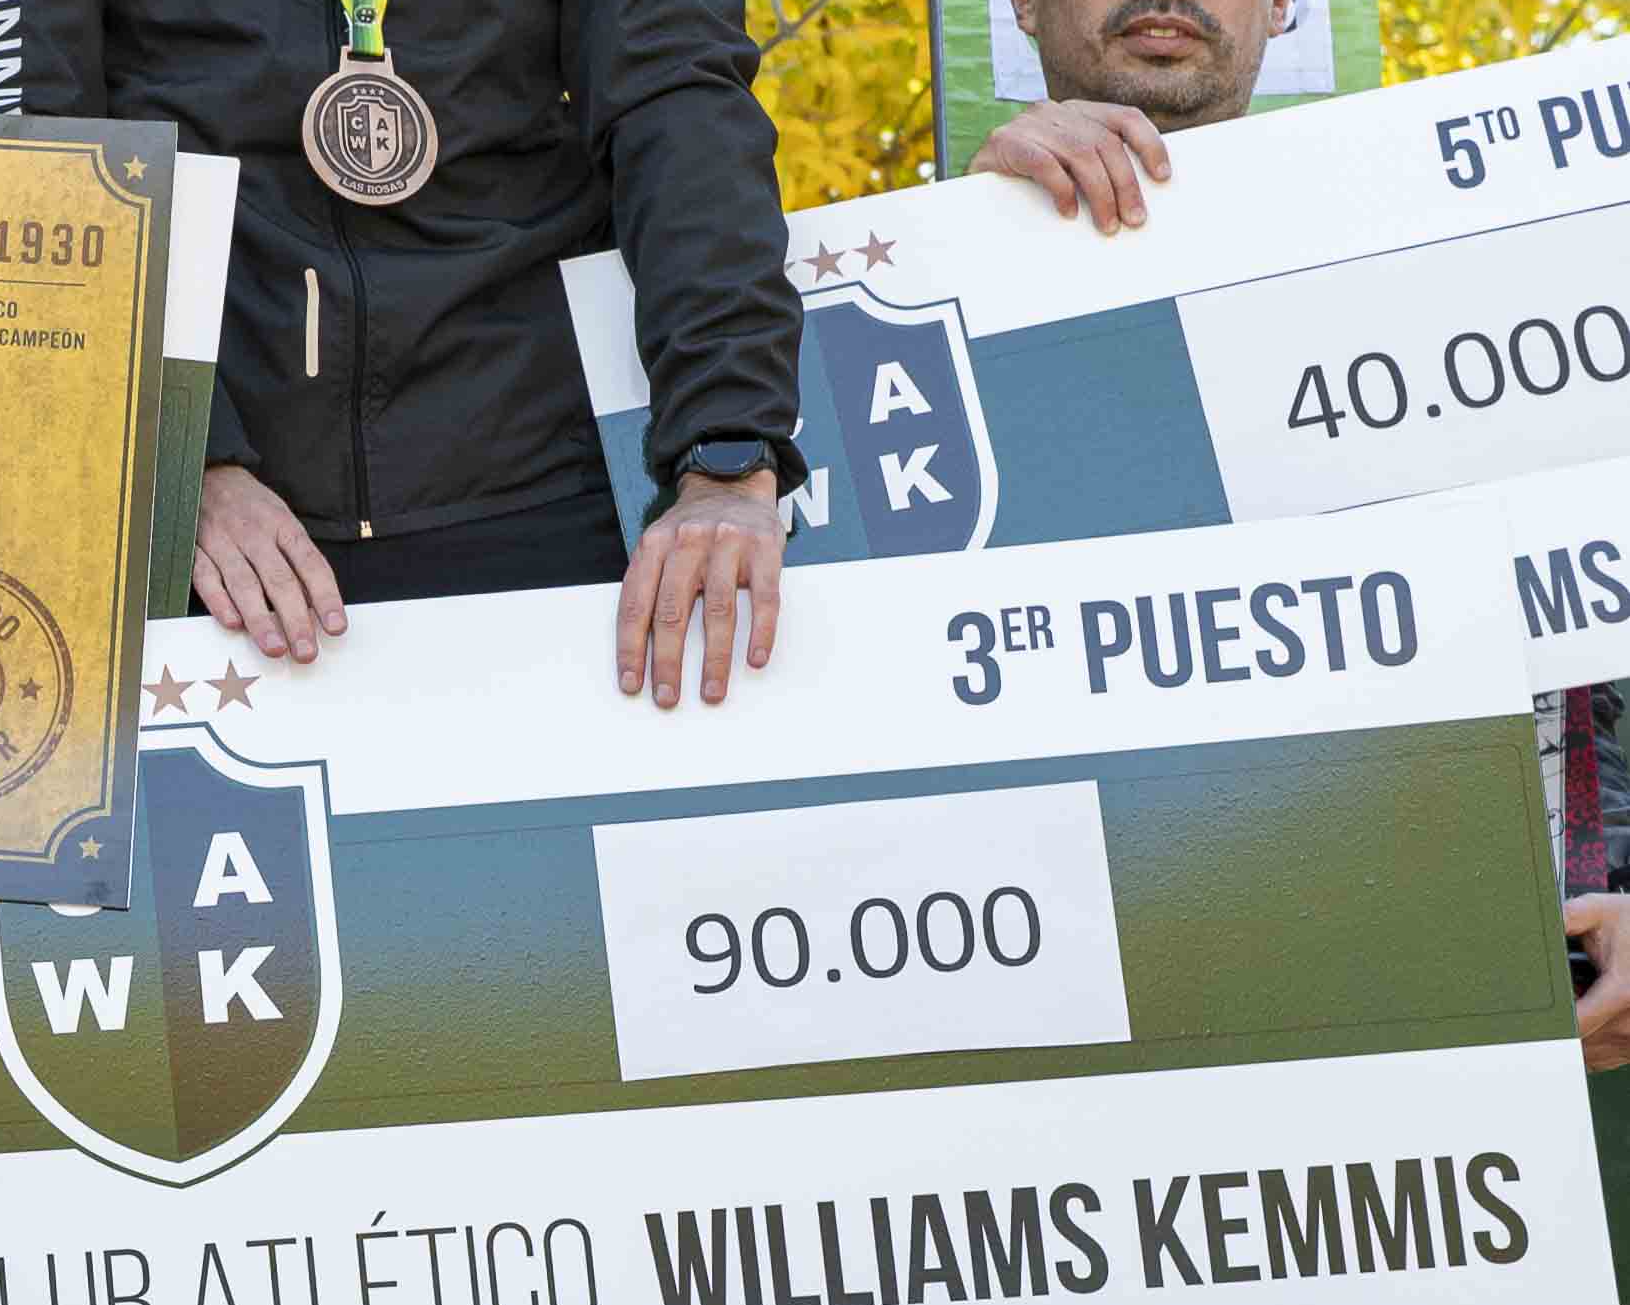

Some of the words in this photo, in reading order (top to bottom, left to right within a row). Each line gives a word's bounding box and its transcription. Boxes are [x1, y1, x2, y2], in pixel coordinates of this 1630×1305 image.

[341, 178, 364, 193] LAS
[367, 180, 405, 194] ROSAS
[868, 362, 932, 424] A
[1285, 305, 1630, 441] 40.000
[879, 444, 953, 512] K
[1081, 569, 1418, 695] PUESTO
[193, 831, 274, 909] A
[684, 886, 1043, 996] 90.000
[32, 955, 134, 1036] W
[197, 946, 284, 1025] K
[1137, 1149, 1533, 1290] KEMMIS
